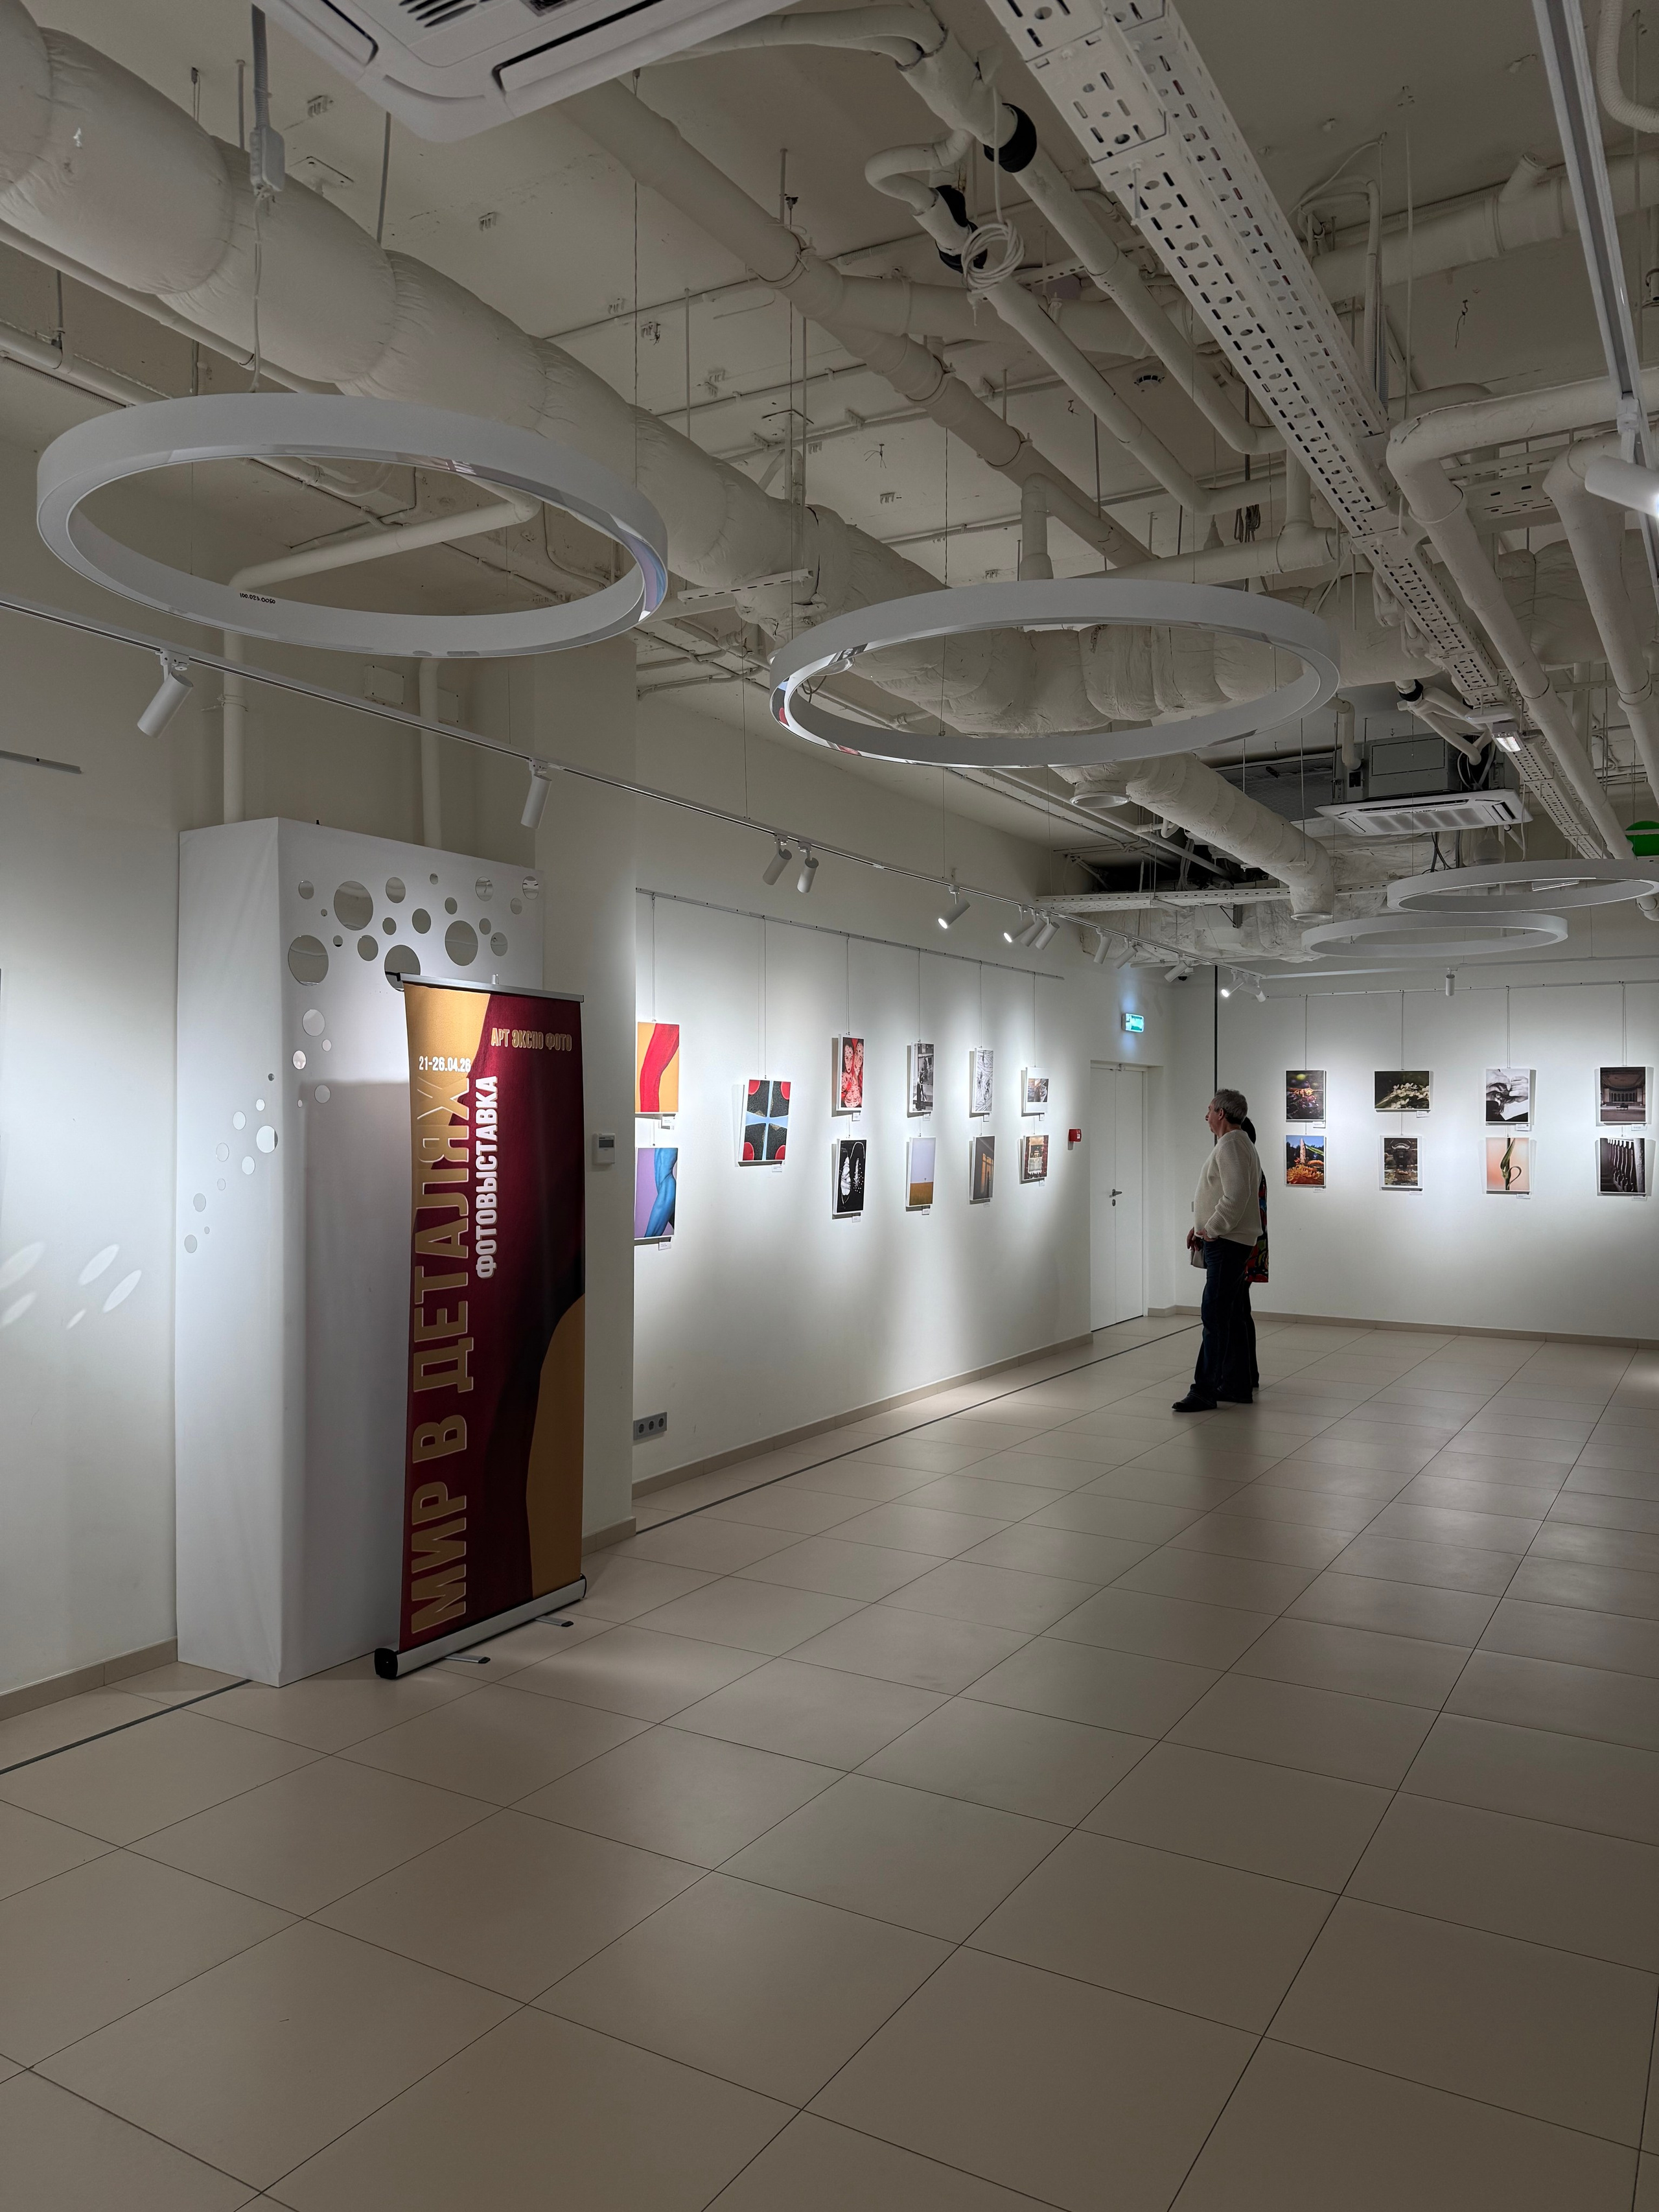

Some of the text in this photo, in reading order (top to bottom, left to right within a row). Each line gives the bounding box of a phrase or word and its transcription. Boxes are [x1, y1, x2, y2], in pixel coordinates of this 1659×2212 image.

[419, 1055, 471, 1073] 21-26.04.26
[491, 1027, 572, 1051] АРТ ЭКСПО ФОТО
[475, 1076, 498, 1280] ФОТОВЫСТАВКА
[411, 1076, 474, 1634] МИР В ДЕТАЛЯХ
